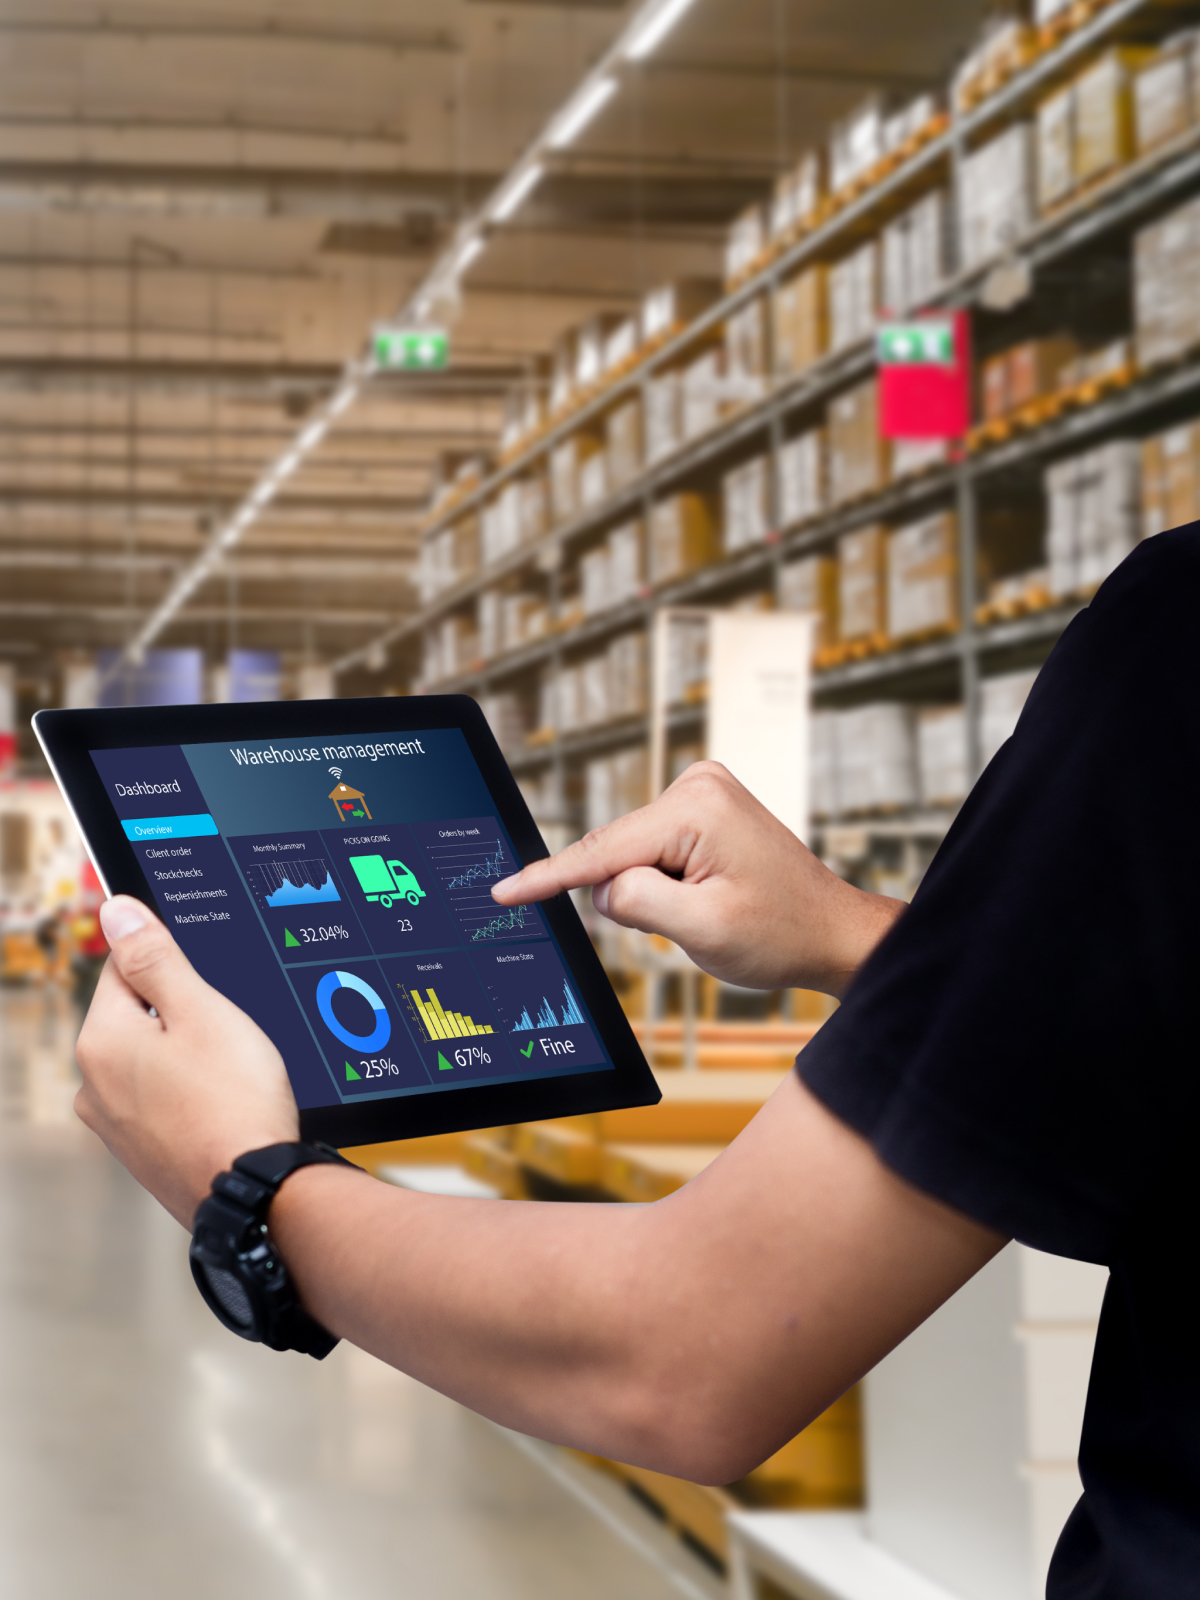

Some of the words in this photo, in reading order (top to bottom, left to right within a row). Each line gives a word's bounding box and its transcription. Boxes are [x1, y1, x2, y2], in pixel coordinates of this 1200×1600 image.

[230, 746, 321, 765] Warehouse
[322, 739, 425, 761] management
[115, 780, 181, 796] Dashboard
[135, 826, 172, 835] Overview
[438, 830, 457, 838] Orders
[457, 828, 465, 838] by
[465, 827, 482, 836] week
[343, 836, 360, 845] PICKS
[361, 836, 370, 844] ON
[371, 834, 391, 843] GOING
[171, 847, 191, 856] order
[252, 843, 277, 853] Monthly
[278, 842, 306, 851] Summary
[154, 868, 203, 880] Stockchecks
[164, 889, 227, 902] Replenishments
[175, 914, 209, 923] Machine
[210, 912, 230, 921] State
[397, 919, 413, 932] 23
[300, 925, 349, 942] 32.04%
[496, 954, 520, 963] Machine
[519, 953, 535, 961] State
[540, 1038, 575, 1056] Fine
[455, 1047, 491, 1066] 67%
[360, 1058, 399, 1078] 25%
